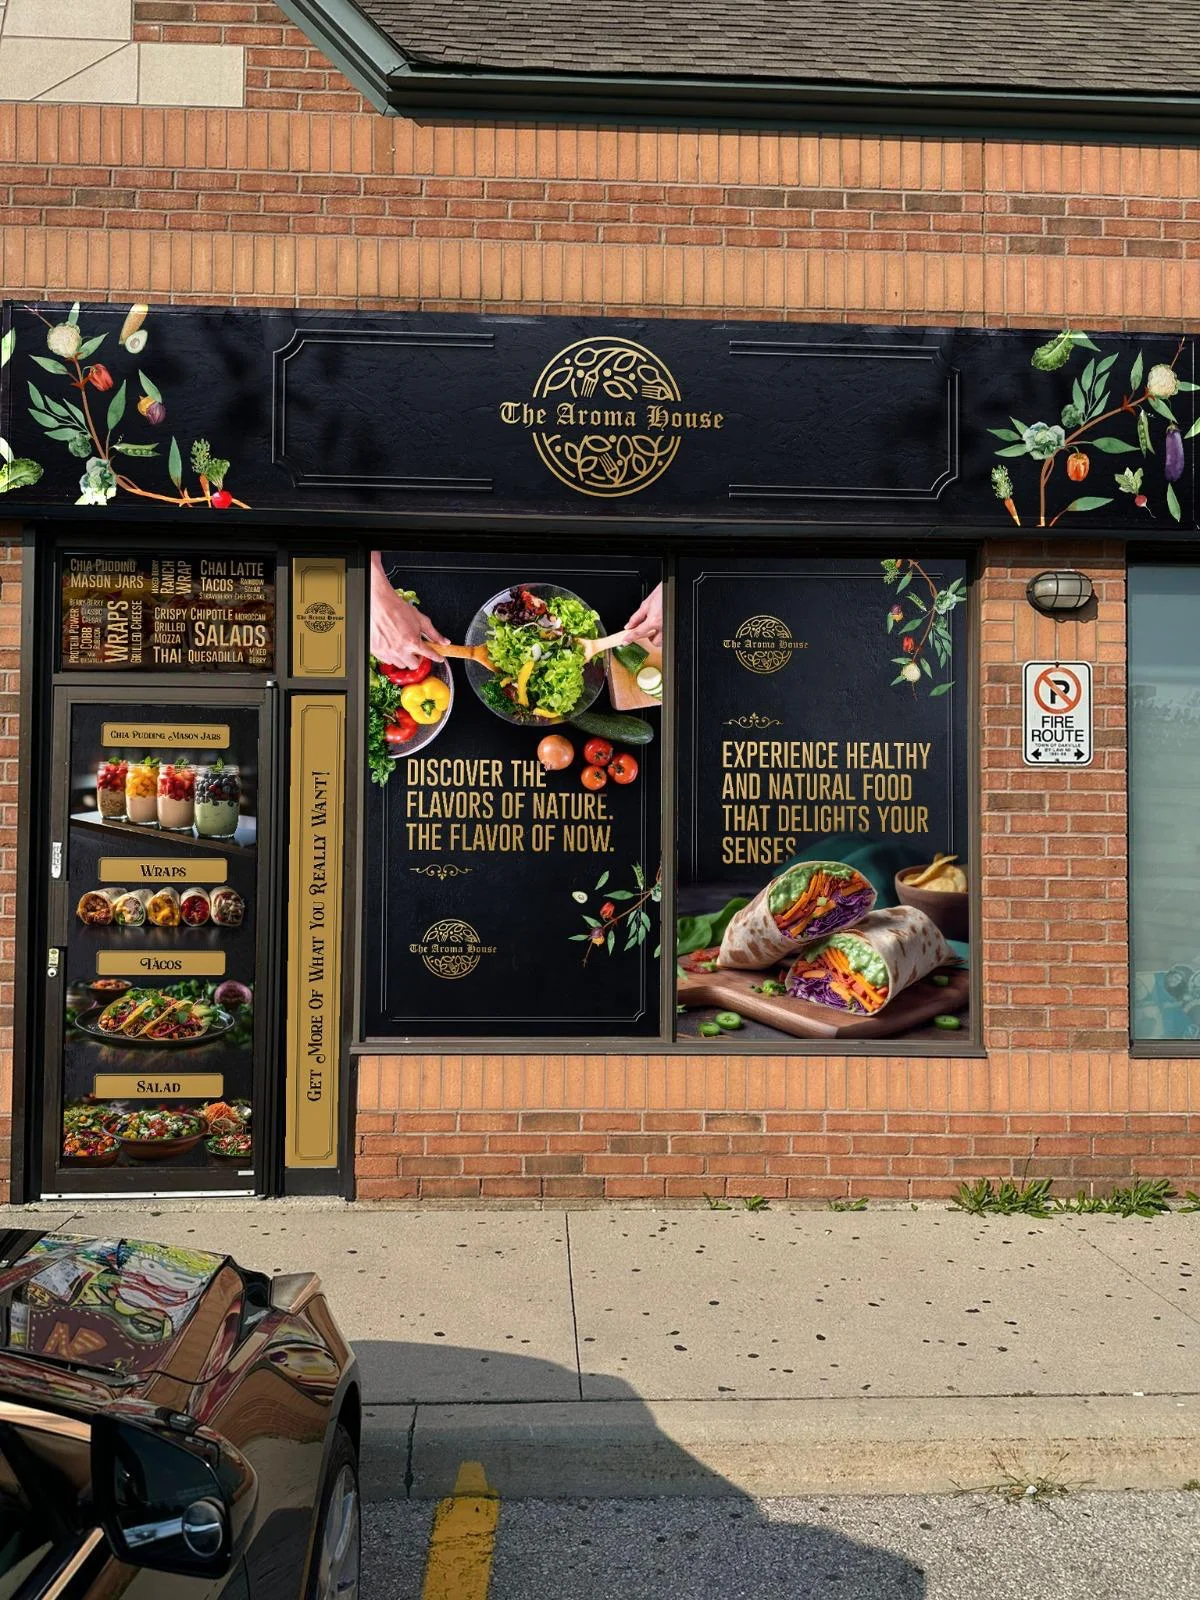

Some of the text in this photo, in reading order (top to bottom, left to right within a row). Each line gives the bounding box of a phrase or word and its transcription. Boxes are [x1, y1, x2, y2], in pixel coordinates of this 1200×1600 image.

[499, 401, 724, 431] The Aroma House
[160, 560, 175, 594] RANCH
[175, 560, 192, 595] WRAP
[80, 627, 93, 650] COBB
[104, 600, 129, 663] WRAPS
[194, 621, 266, 648] SALADS
[723, 639, 742, 649] The
[744, 639, 776, 649] Aroma
[152, 646, 182, 664] THAI
[1031, 729, 1085, 743] ROUTE
[1041, 715, 1074, 729] FIRE
[722, 741, 932, 770] EXPERIENCE HEALTHY
[407, 758, 547, 788] DISCOVER THE
[722, 773, 912, 802] AND NATURAL FOOD
[406, 791, 614, 820] FLAVORS OF NATURE.
[722, 804, 929, 834] THAT DELIGHTS YOUR
[405, 823, 615, 853] THE FLAVOR OF NOW.
[140, 864, 187, 877] WRAPS
[306, 771, 331, 1103] GET MORE OF WHAT YOU REALLY WANT!
[409, 943, 498, 954] The Aroma House
[139, 956, 183, 970] TACOS
[136, 1080, 181, 1094] SALAD
